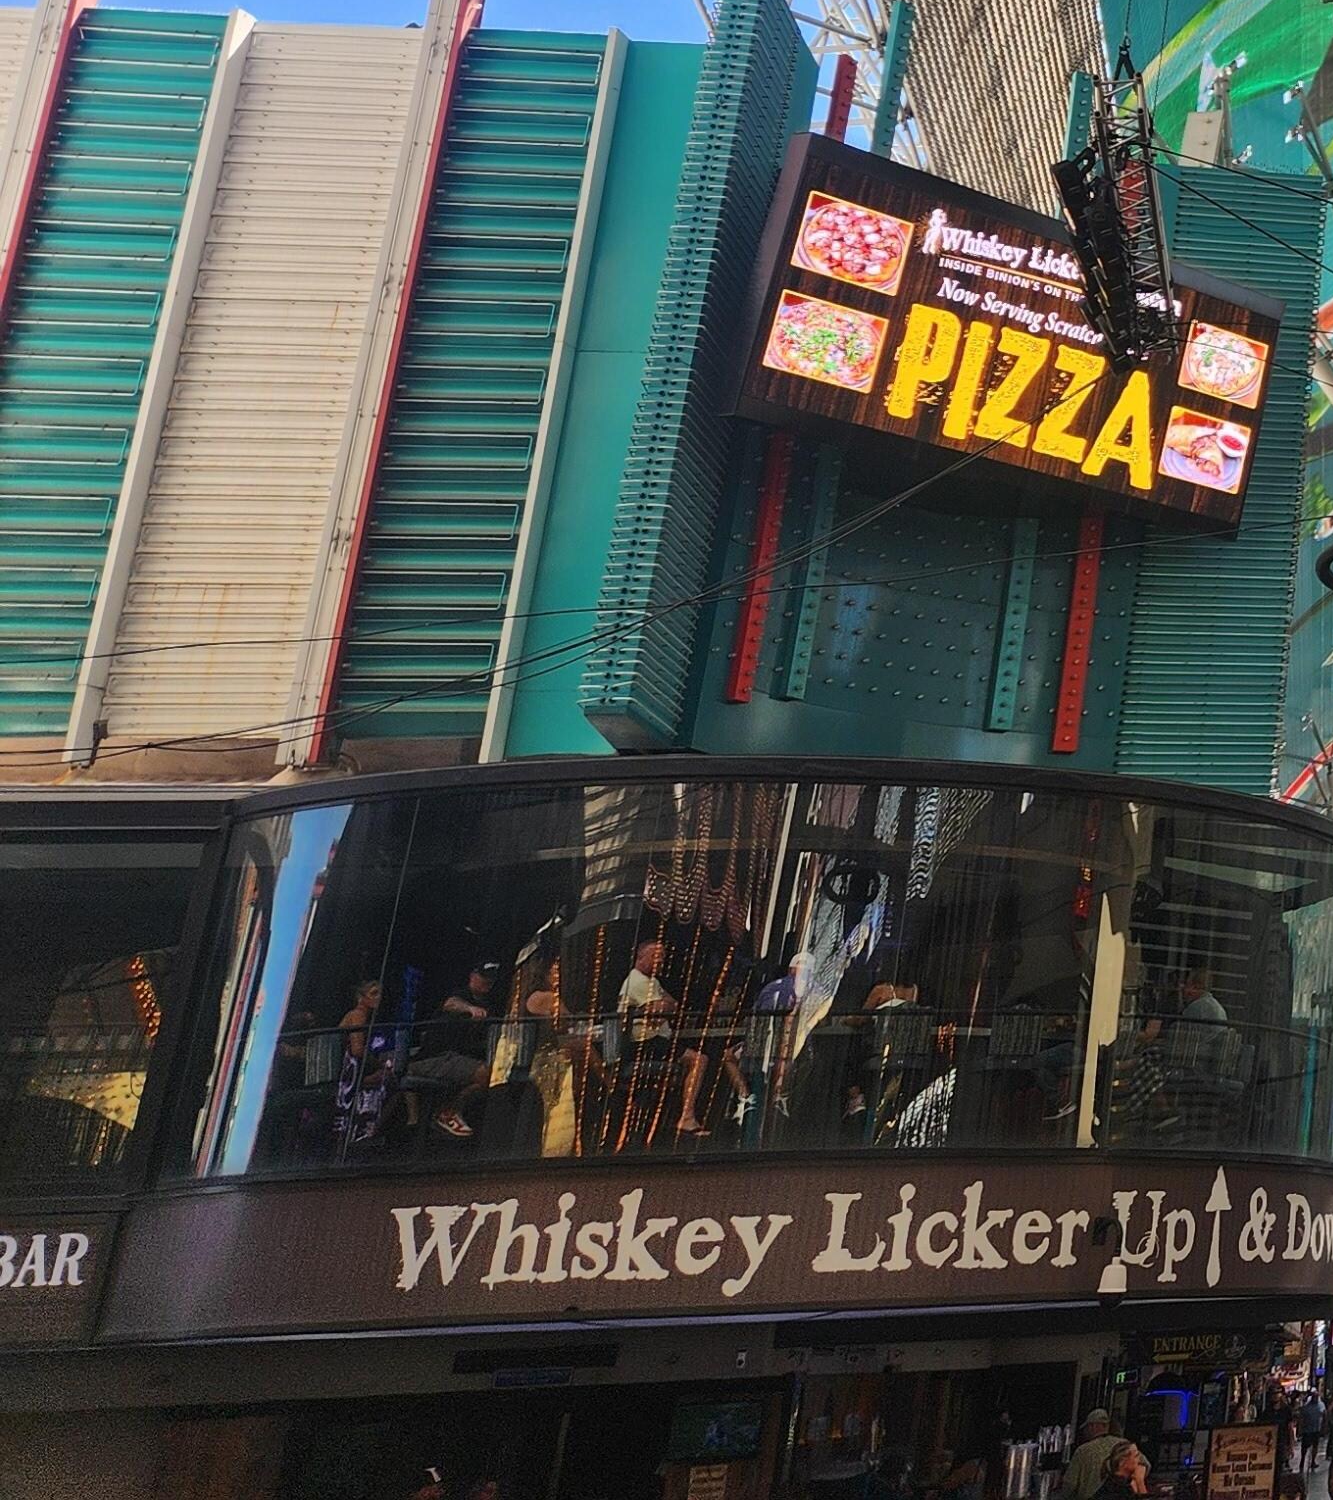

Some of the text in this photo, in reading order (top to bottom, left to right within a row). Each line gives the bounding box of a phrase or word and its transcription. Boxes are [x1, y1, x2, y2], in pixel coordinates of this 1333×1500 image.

[941, 226, 1028, 269] Whiskey
[936, 276, 981, 308] Now
[980, 291, 1045, 333] Serving
[938, 257, 1086, 303] INSIDE BINION'S ON TH
[884, 303, 1154, 491] PIZZA
[389, 1187, 793, 1298] Whiskey
[811, 1180, 1089, 1273] Licker
[1111, 1188, 1197, 1284] Up
[1238, 1186, 1277, 1264] &
[1153, 1334, 1222, 1351] ENTRANCE
